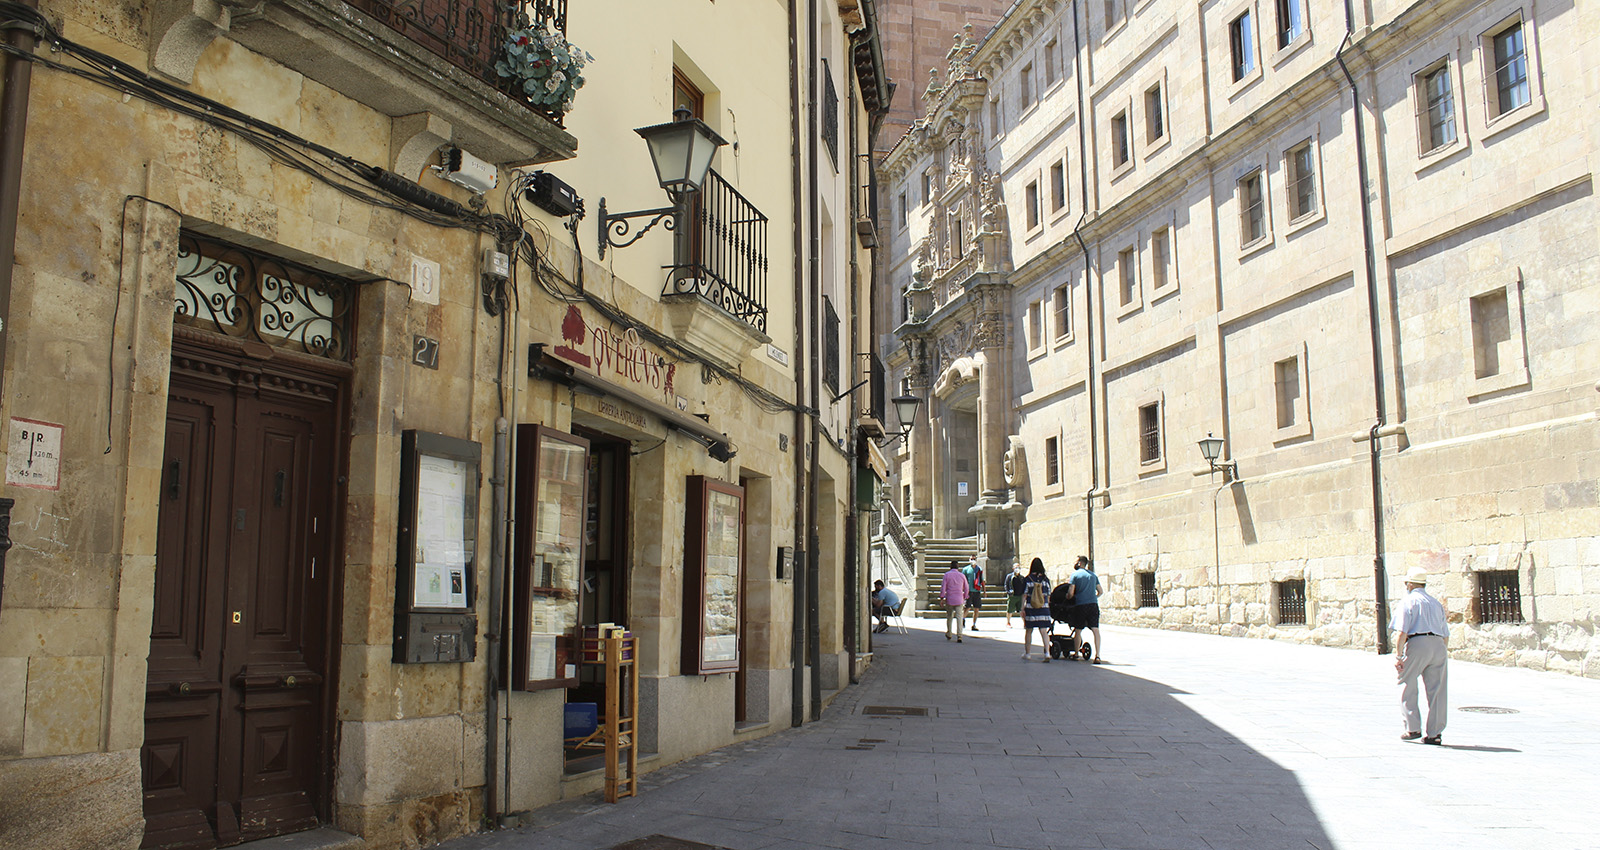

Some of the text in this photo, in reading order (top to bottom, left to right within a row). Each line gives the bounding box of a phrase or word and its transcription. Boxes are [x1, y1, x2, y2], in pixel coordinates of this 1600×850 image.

[412, 263, 433, 294] 19
[415, 338, 439, 366] 27
[593, 327, 660, 389] QVERCVS
[19, 469, 29, 477] 45
